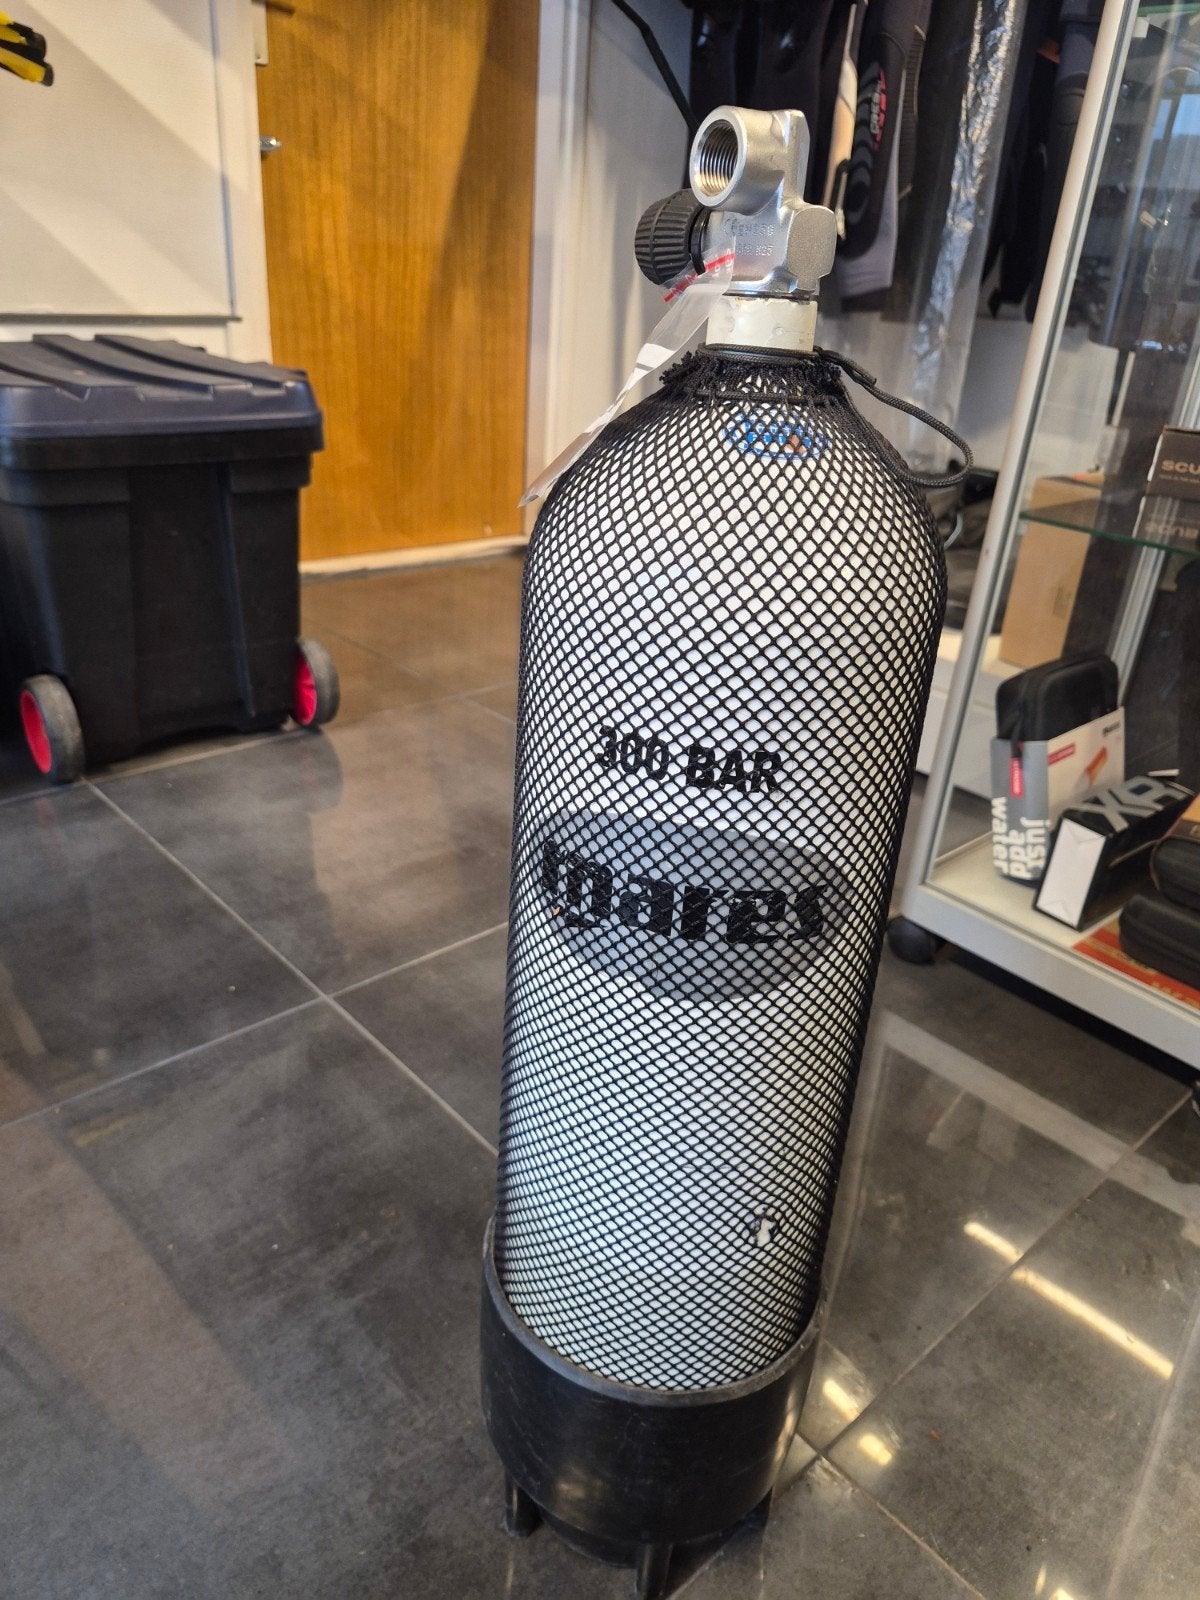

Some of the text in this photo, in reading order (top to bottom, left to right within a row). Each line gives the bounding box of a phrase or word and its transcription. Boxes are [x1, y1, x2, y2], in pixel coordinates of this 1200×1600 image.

[596, 725, 781, 794] 300 BAR
[991, 796, 1010, 875] water
[1064, 775, 1190, 833] XR
[1008, 829, 1033, 879] add
[542, 838, 829, 944] mares
